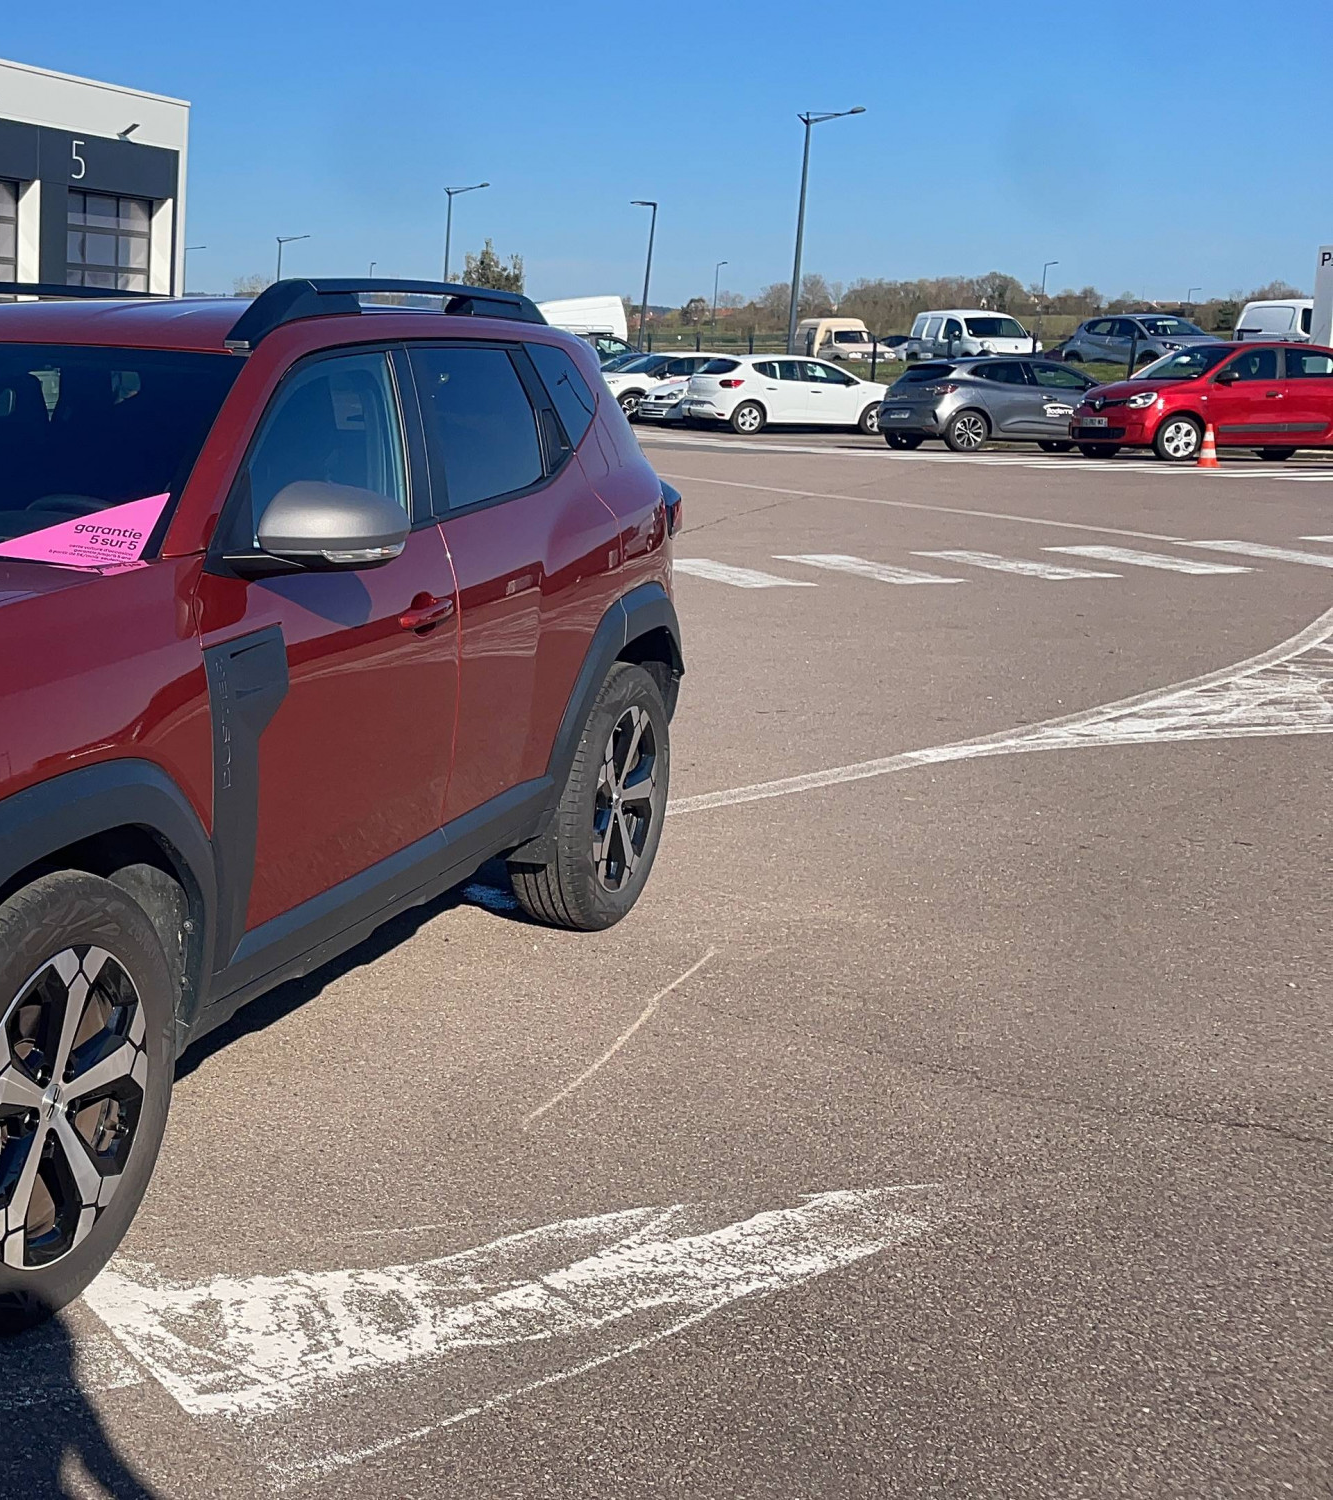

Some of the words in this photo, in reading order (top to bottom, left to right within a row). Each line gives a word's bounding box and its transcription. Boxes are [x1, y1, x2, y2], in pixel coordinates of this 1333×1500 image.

[71, 140, 86, 179] 5
[73, 523, 143, 540] garantie
[89, 535, 100, 545] 5
[100, 538, 127, 548] sur
[127, 541, 139, 551] 5
